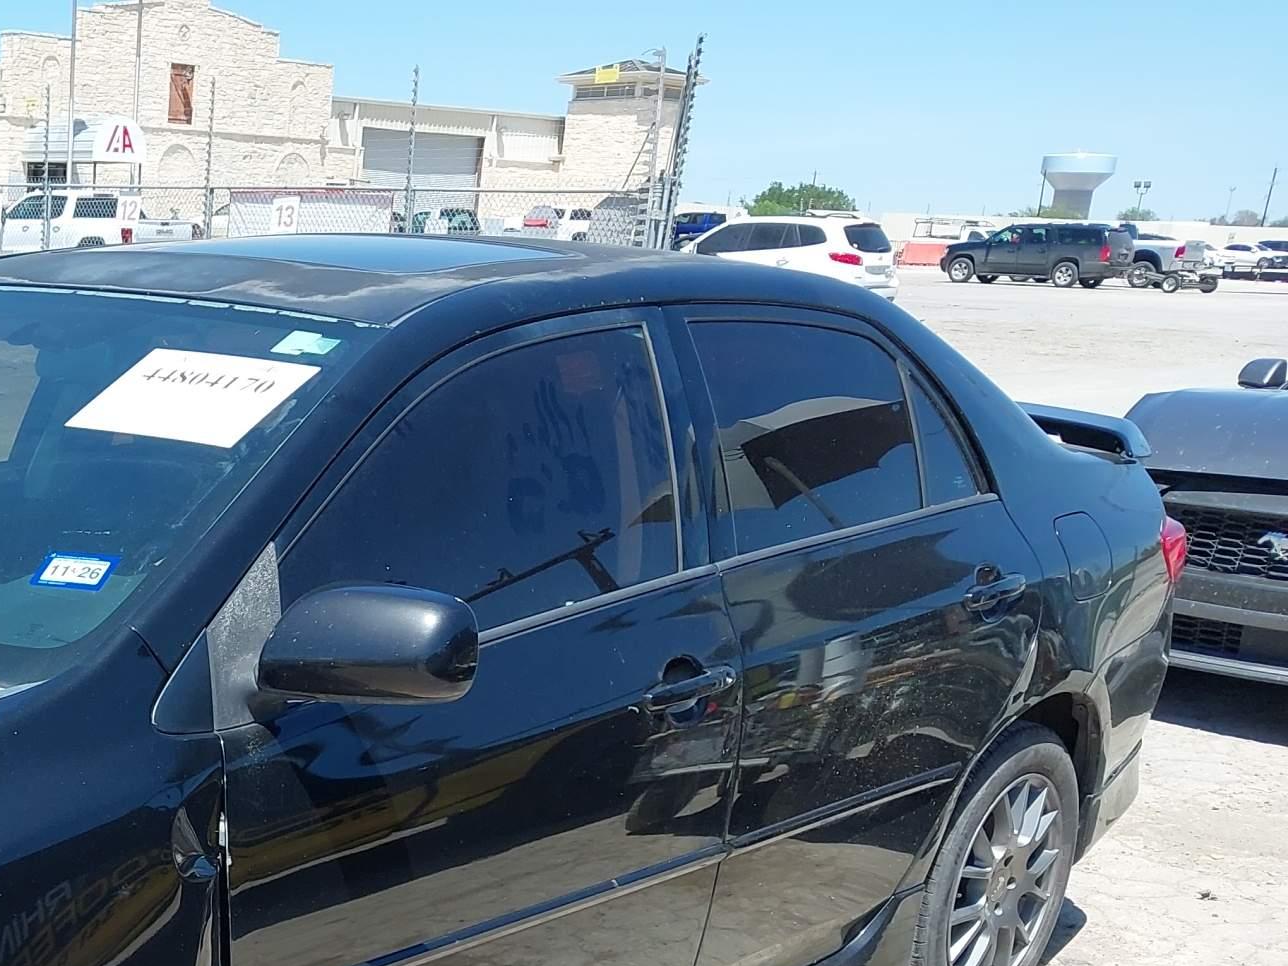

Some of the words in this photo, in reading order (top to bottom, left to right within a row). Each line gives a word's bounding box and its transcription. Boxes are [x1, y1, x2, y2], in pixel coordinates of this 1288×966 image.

[120, 199, 138, 221] 12
[275, 204, 295, 227] 13
[142, 367, 276, 393] 44804170
